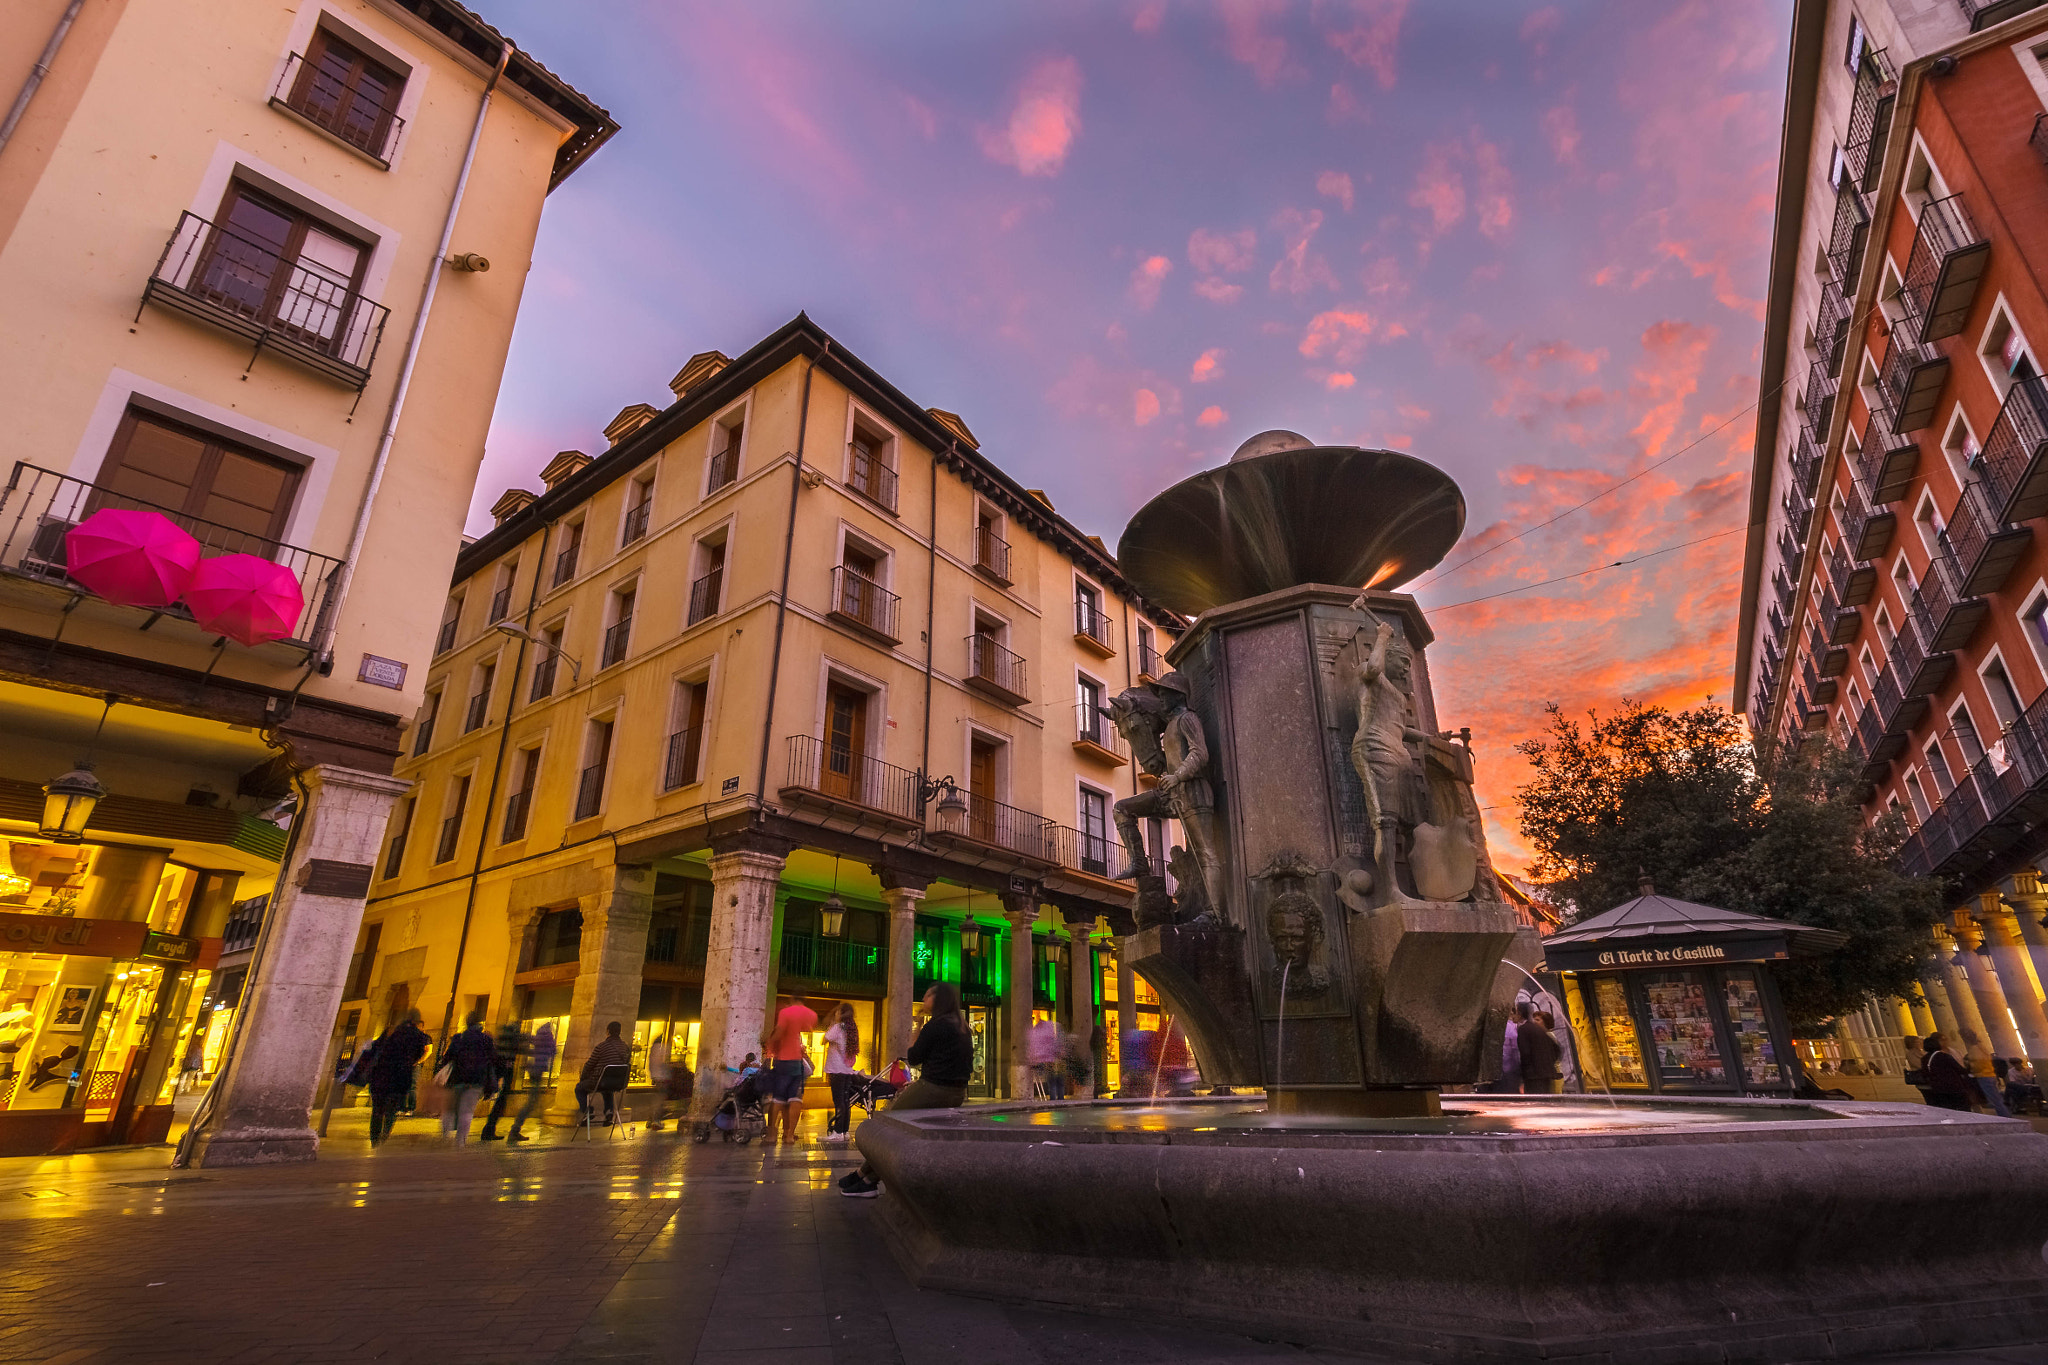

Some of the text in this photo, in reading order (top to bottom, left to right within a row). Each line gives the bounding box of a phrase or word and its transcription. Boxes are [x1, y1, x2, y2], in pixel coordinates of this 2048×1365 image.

[156, 941, 188, 957] roydi
[1599, 945, 1725, 965] El Norte de Castilla
